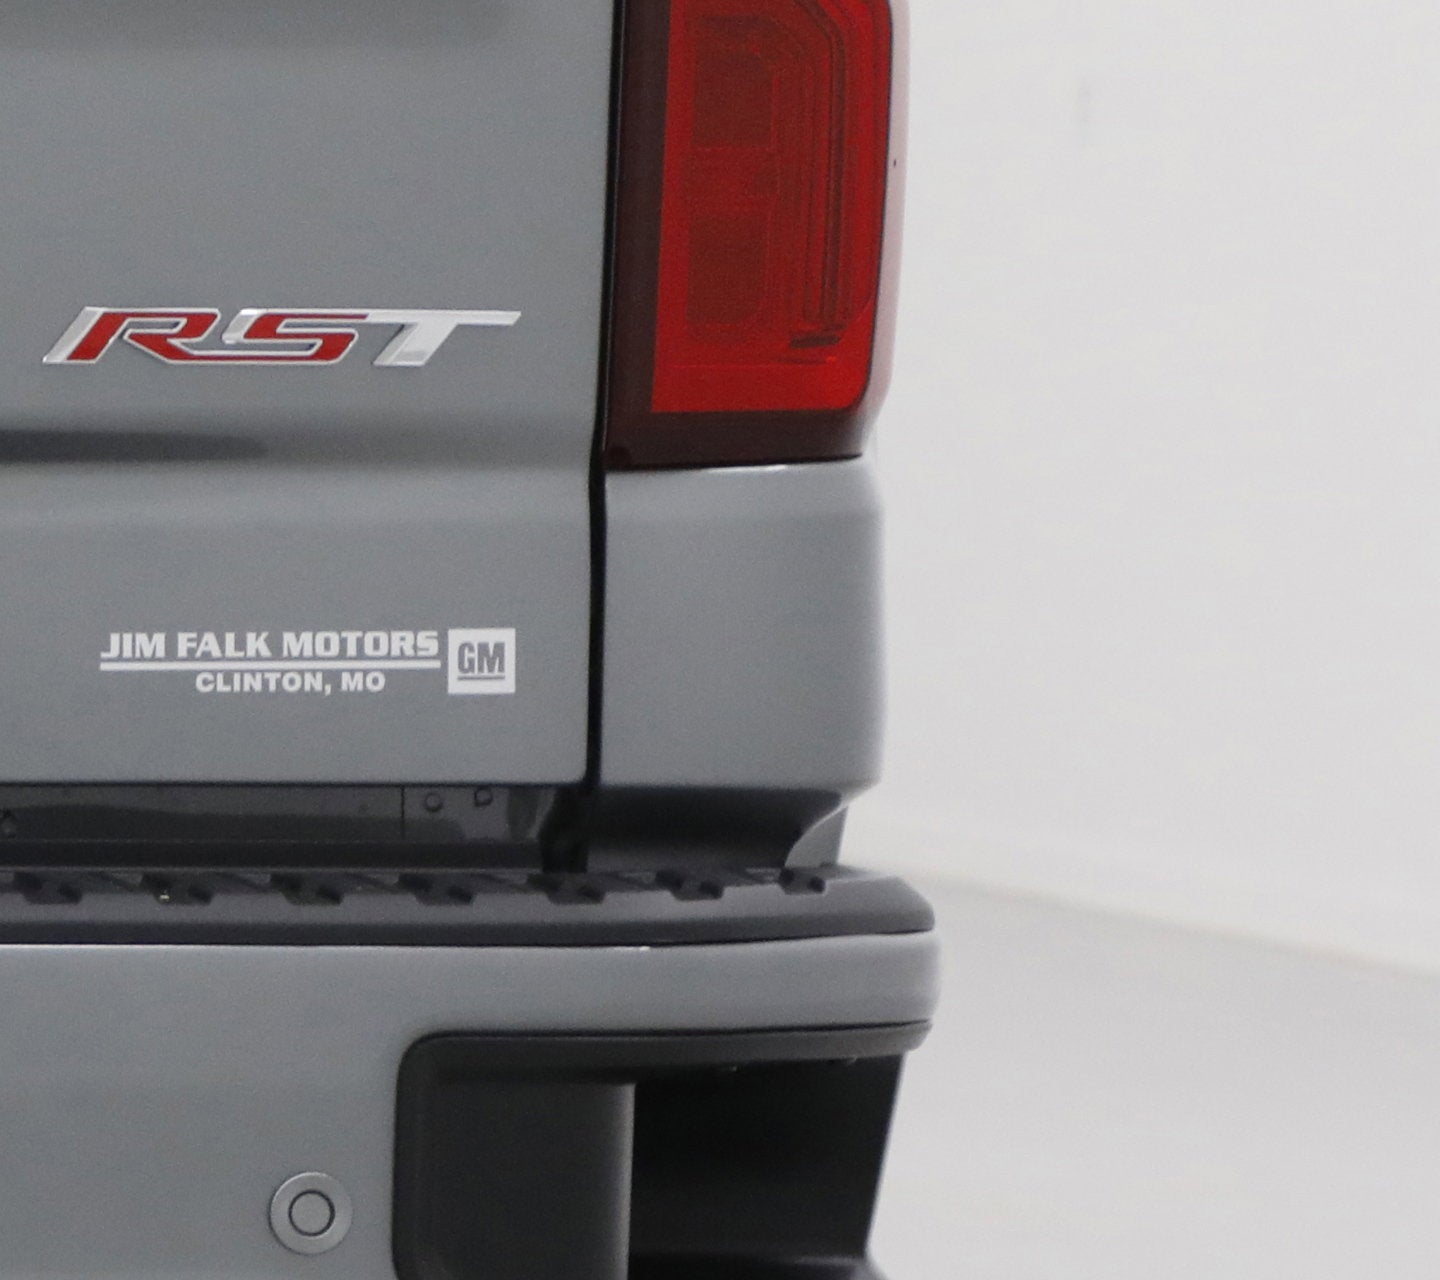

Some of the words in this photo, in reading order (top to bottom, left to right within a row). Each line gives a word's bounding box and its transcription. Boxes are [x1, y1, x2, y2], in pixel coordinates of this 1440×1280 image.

[42, 306, 522, 367] RST
[100, 632, 167, 660] JIM
[177, 632, 273, 658] FALK
[282, 630, 440, 658] MOTORS
[457, 641, 505, 675] GM
[194, 671, 332, 696] CLINTON,
[340, 672, 386, 693] MO
